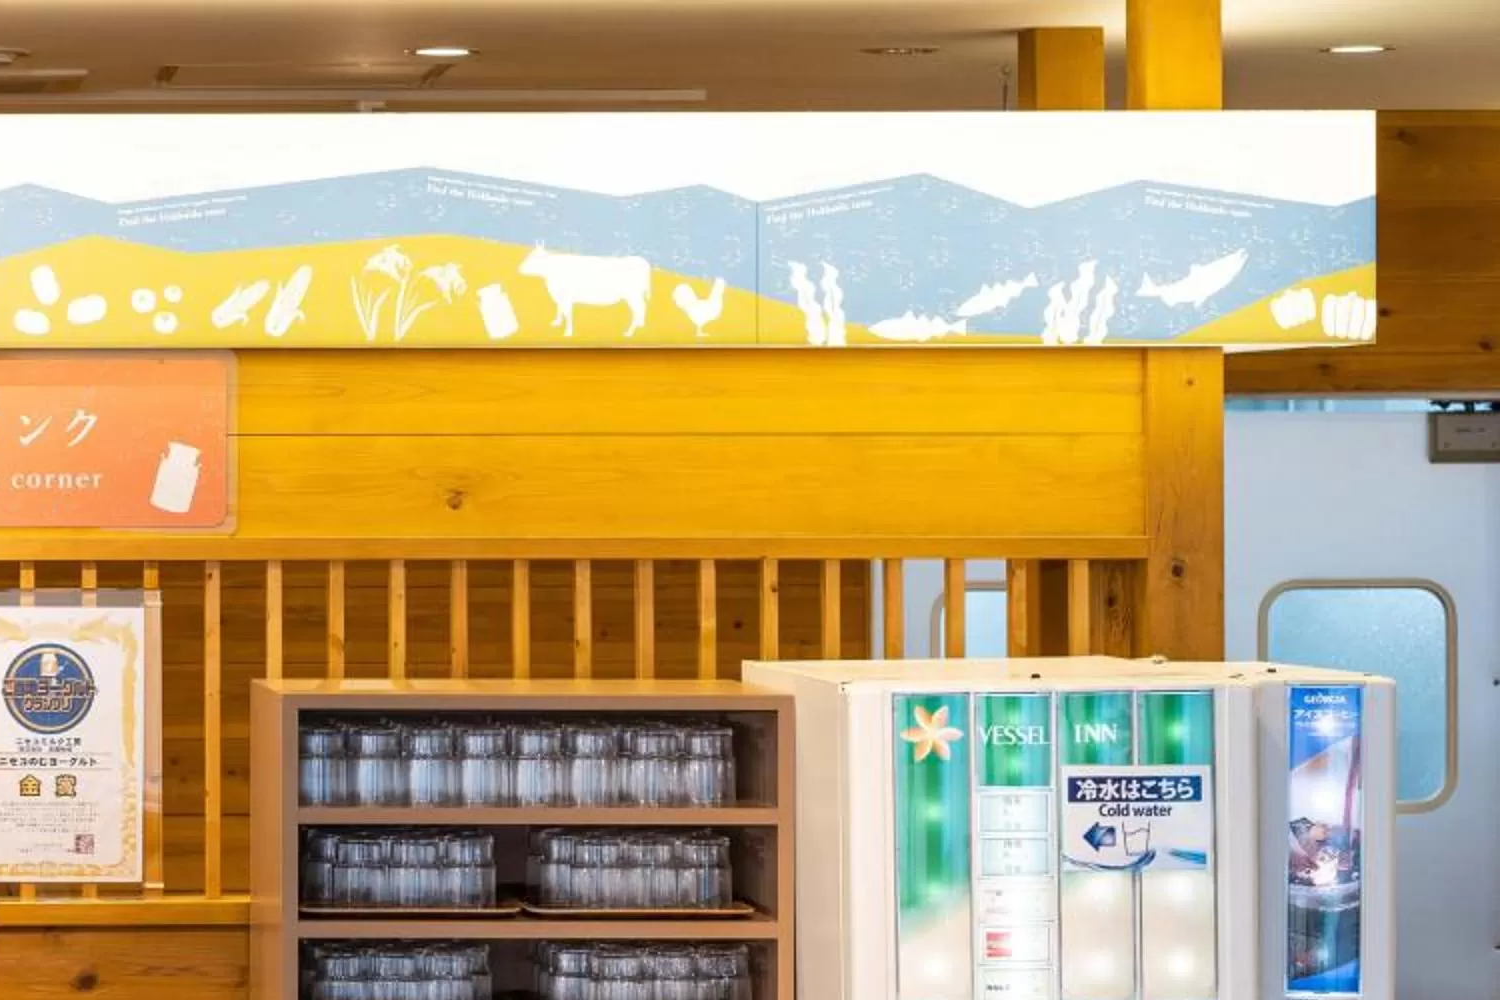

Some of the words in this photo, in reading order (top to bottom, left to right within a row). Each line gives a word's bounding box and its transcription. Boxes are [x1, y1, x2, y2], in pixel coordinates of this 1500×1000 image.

[10, 471, 104, 490] corner
[979, 724, 1051, 746] VESSEL
[1073, 723, 1119, 745] INN
[1075, 778, 1195, 801] 冷水はこちら
[1098, 803, 1131, 818] Cold
[1132, 806, 1173, 818] water
